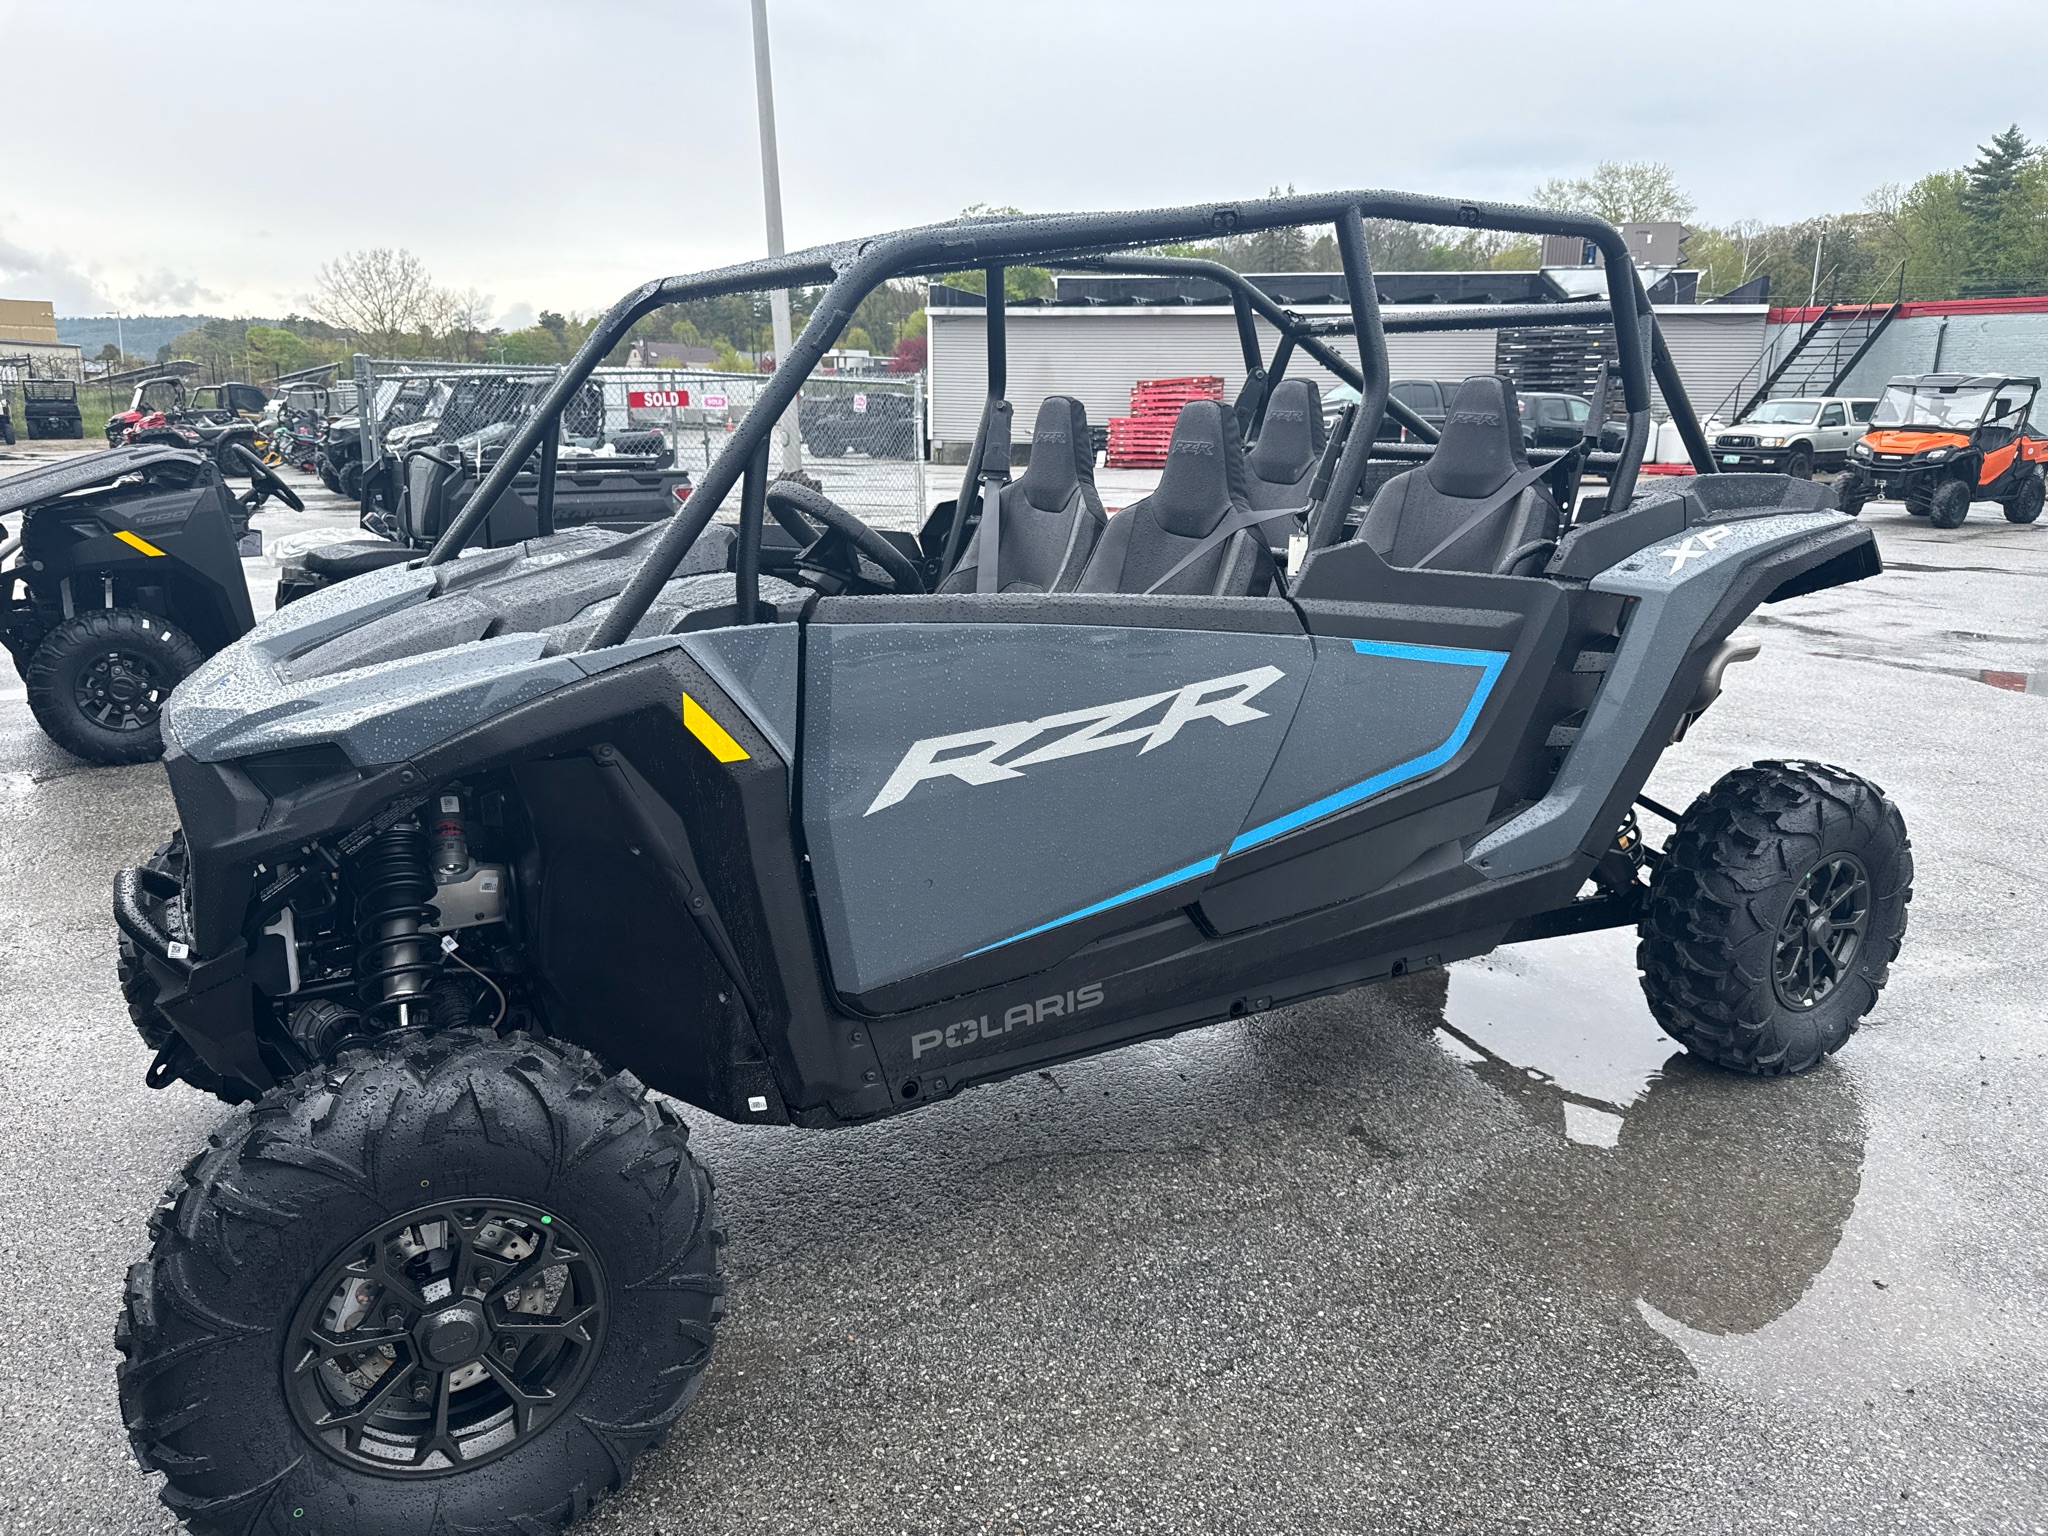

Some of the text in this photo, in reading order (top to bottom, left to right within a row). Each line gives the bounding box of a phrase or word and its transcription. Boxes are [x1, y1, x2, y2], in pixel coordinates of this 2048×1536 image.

[643, 391, 679, 407] SOLD
[1266, 410, 1304, 422] RZR
[1450, 411, 1499, 426] RZR
[1035, 431, 1066, 444] RZR
[1172, 440, 1214, 455] RZR
[136, 510, 187, 524] 1000
[1657, 524, 1733, 577] XP
[862, 664, 1287, 818] RZR
[911, 982, 1105, 1060] POLARIS
